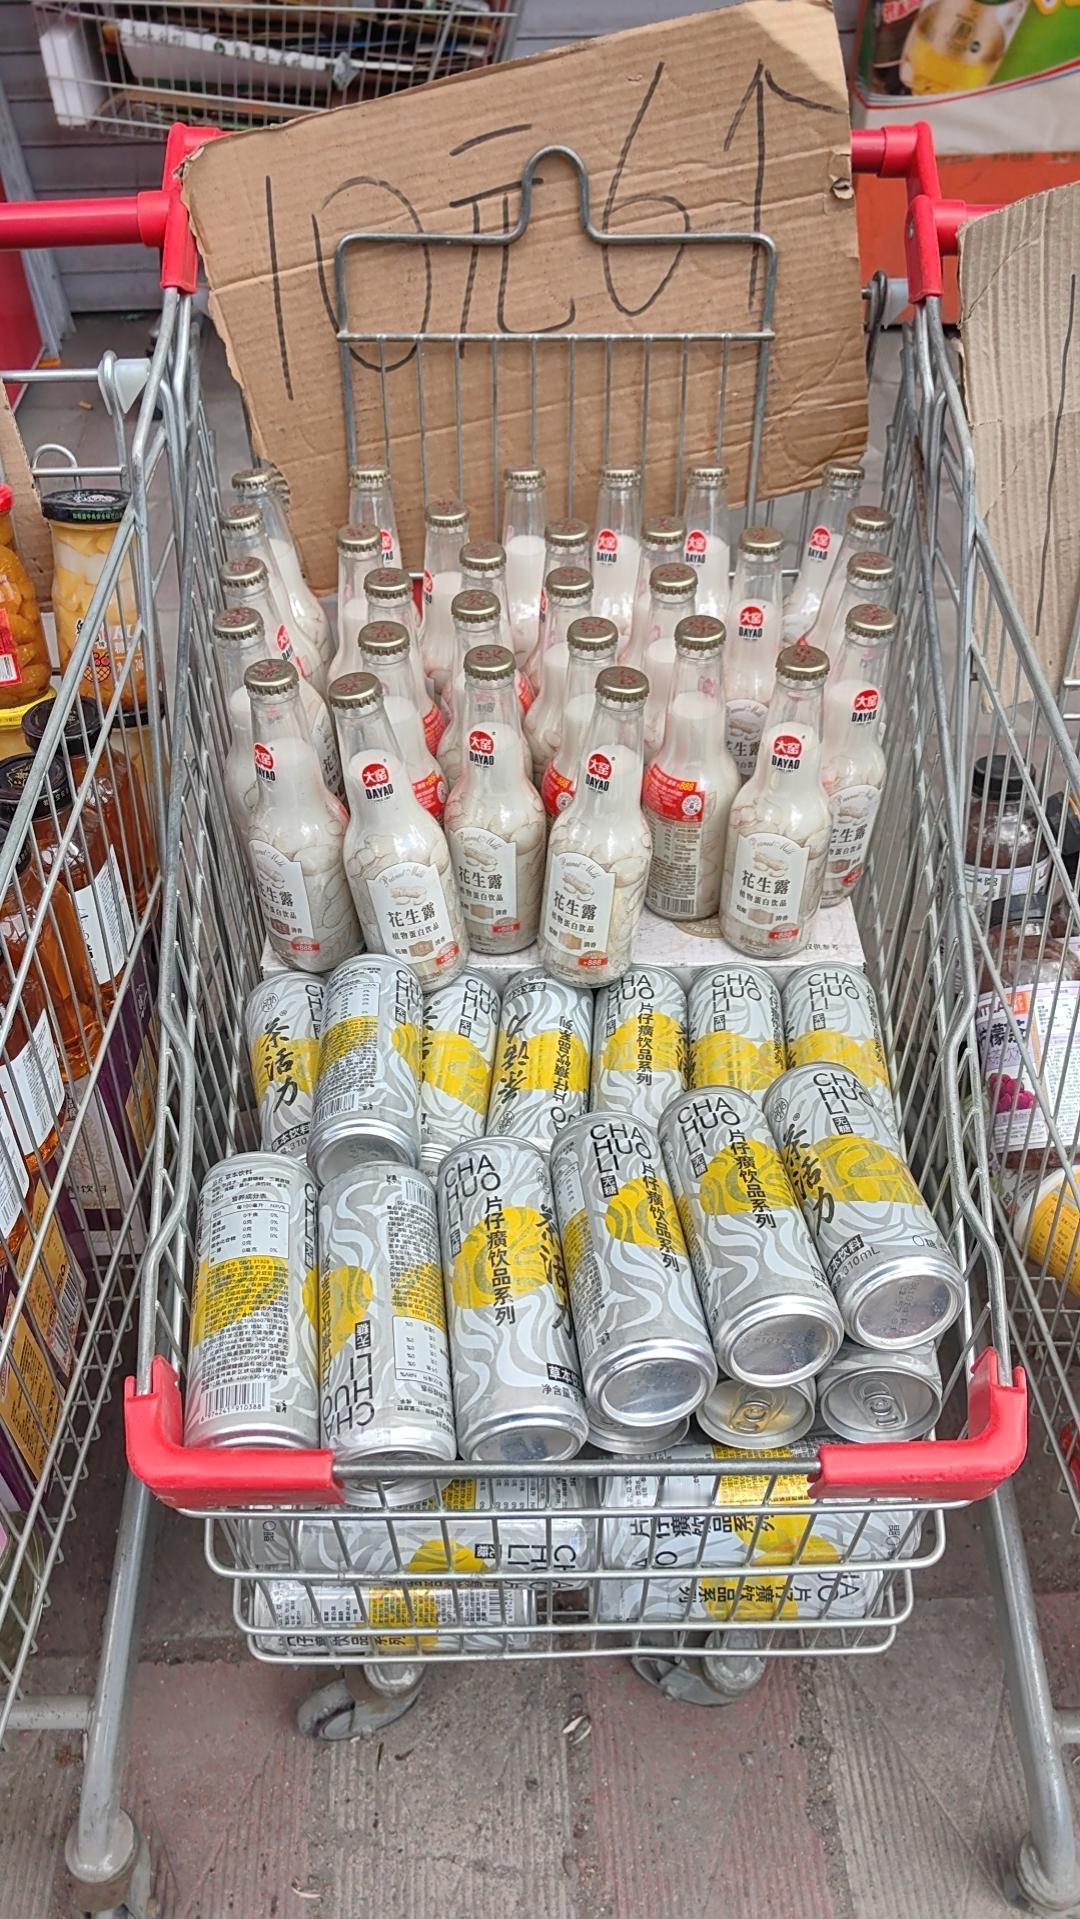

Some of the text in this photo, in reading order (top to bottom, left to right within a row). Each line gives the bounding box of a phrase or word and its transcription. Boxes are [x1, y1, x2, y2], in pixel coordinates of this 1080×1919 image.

[596, 551, 617, 563] DAYAO
[685, 551, 706, 563] DAYAO
[807, 548, 828, 560] DAYAO
[738, 626, 763, 638] DAYAO
[851, 709, 878, 722] DAYAO
[470, 737, 492, 752] 大窑
[775, 740, 801, 755] 大窑
[469, 753, 495, 766] DAYAO
[589, 760, 611, 776] 大窑
[771, 756, 801, 770] DAYAO
[364, 768, 389, 783] 大窑
[585, 773, 610, 791] DAYAO
[366, 783, 394, 800] DAYAO
[458, 867, 503, 890] 花生露
[741, 869, 792, 894] 花生露
[385, 901, 436, 929] 花生露
[553, 890, 598, 921] 花生露
[711, 973, 758, 989] CHA
[807, 972, 857, 988] CHA
[608, 987, 655, 1003] HUO
[712, 984, 763, 1002] HUO
[809, 983, 861, 1000] HUO
[713, 998, 730, 1014] LI
[811, 997, 829, 1014] LI
[635, 1002, 655, 1086] 片仔癀饮品系列
[261, 1016, 299, 1114] 茶活力
[813, 1072, 866, 1091] CHA
[677, 1096, 735, 1124] CHA
[824, 1099, 851, 1115] LI
[590, 1123, 646, 1144] CHA
[681, 1110, 741, 1141] HUO
[831, 1115, 854, 1136] 无糖
[592, 1138, 652, 1160] HUO
[685, 1132, 707, 1156] LI
[444, 1153, 496, 1188] CHA
[596, 1154, 620, 1173] LI
[600, 1174, 619, 1198] 无糖
[728, 1128, 777, 1229] 片仔癀饮品系列
[445, 1172, 501, 1205] HUO
[447, 1202, 464, 1230] LI
[641, 1161, 680, 1273] 片仔癀饮品系列
[483, 1195, 517, 1327] 片仔癀饮品系列
[354, 1319, 371, 1351] 无糖
[349, 1353, 373, 1380] LI
[323, 1400, 376, 1441] CHA
